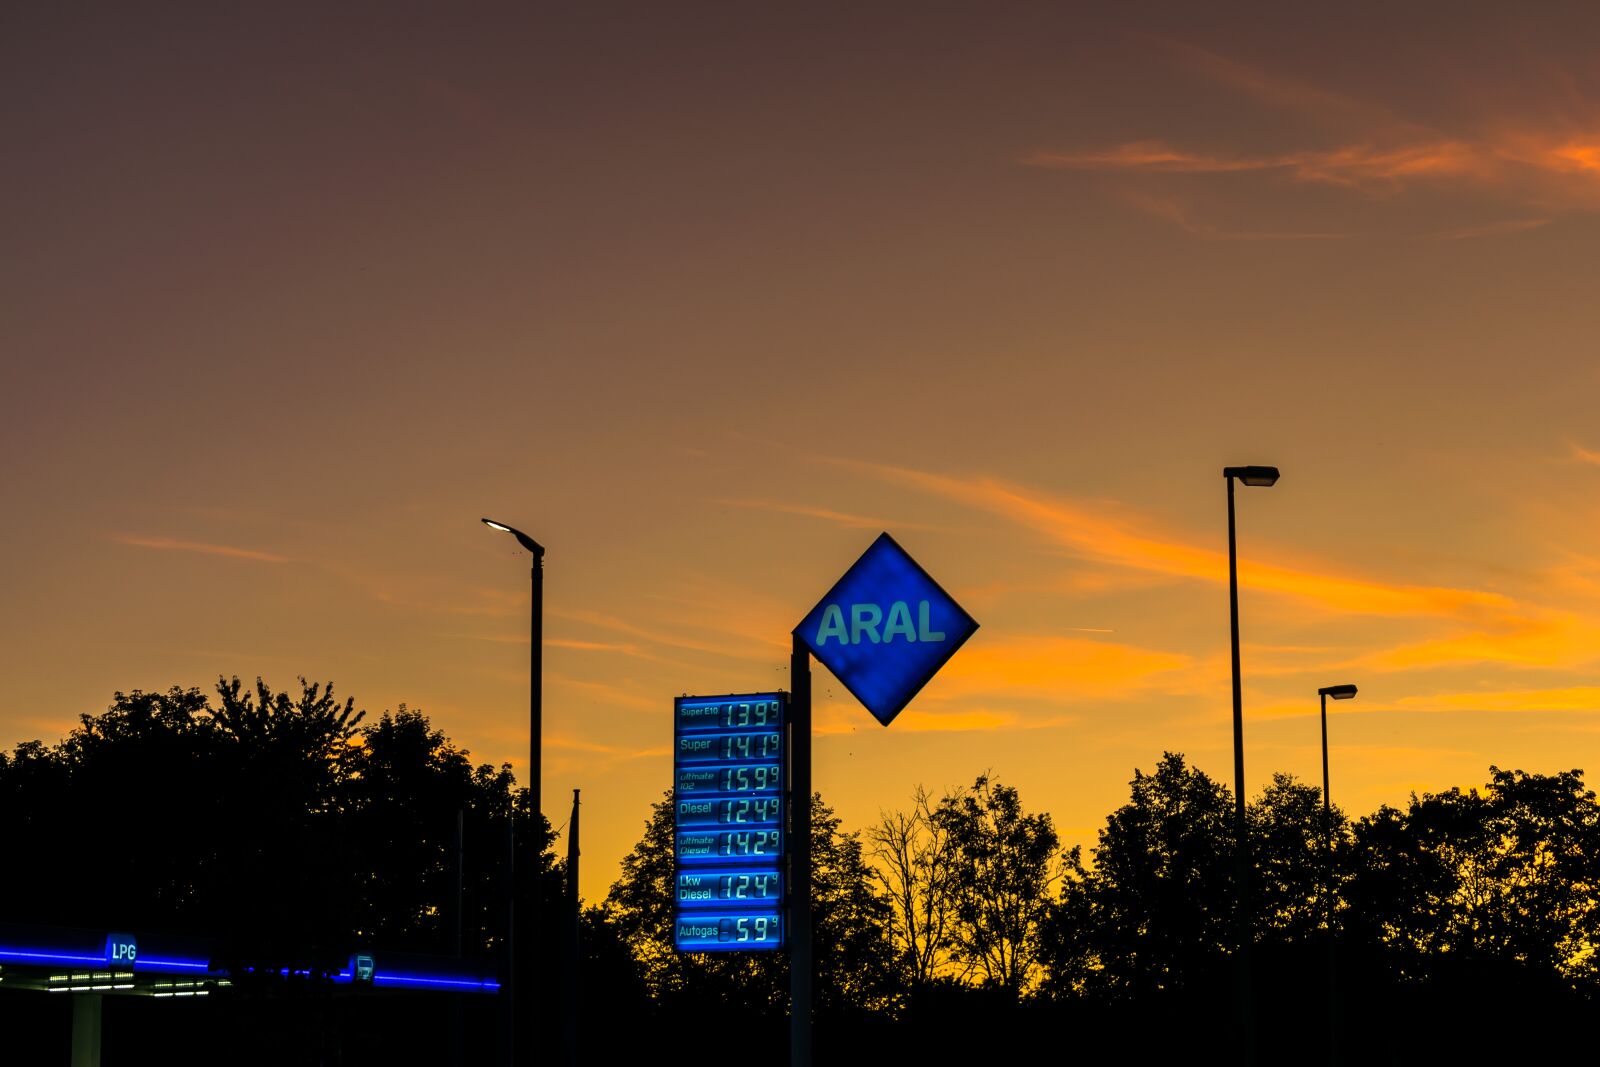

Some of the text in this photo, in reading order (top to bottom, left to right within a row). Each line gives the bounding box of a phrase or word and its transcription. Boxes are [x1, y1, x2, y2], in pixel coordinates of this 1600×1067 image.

[815, 600, 947, 647] ARAL
[681, 707, 718, 716] Super E10
[681, 739, 711, 751] Super
[680, 772, 714, 780] ultimate
[680, 782, 695, 790] 102
[680, 803, 712, 814] Diesel
[680, 836, 714, 845] ultimate
[680, 846, 710, 855] Diesel
[680, 875, 701, 887] Lkw
[680, 889, 712, 900] Diesel
[680, 926, 718, 938] Autogas
[112, 943, 136, 960] LPG
